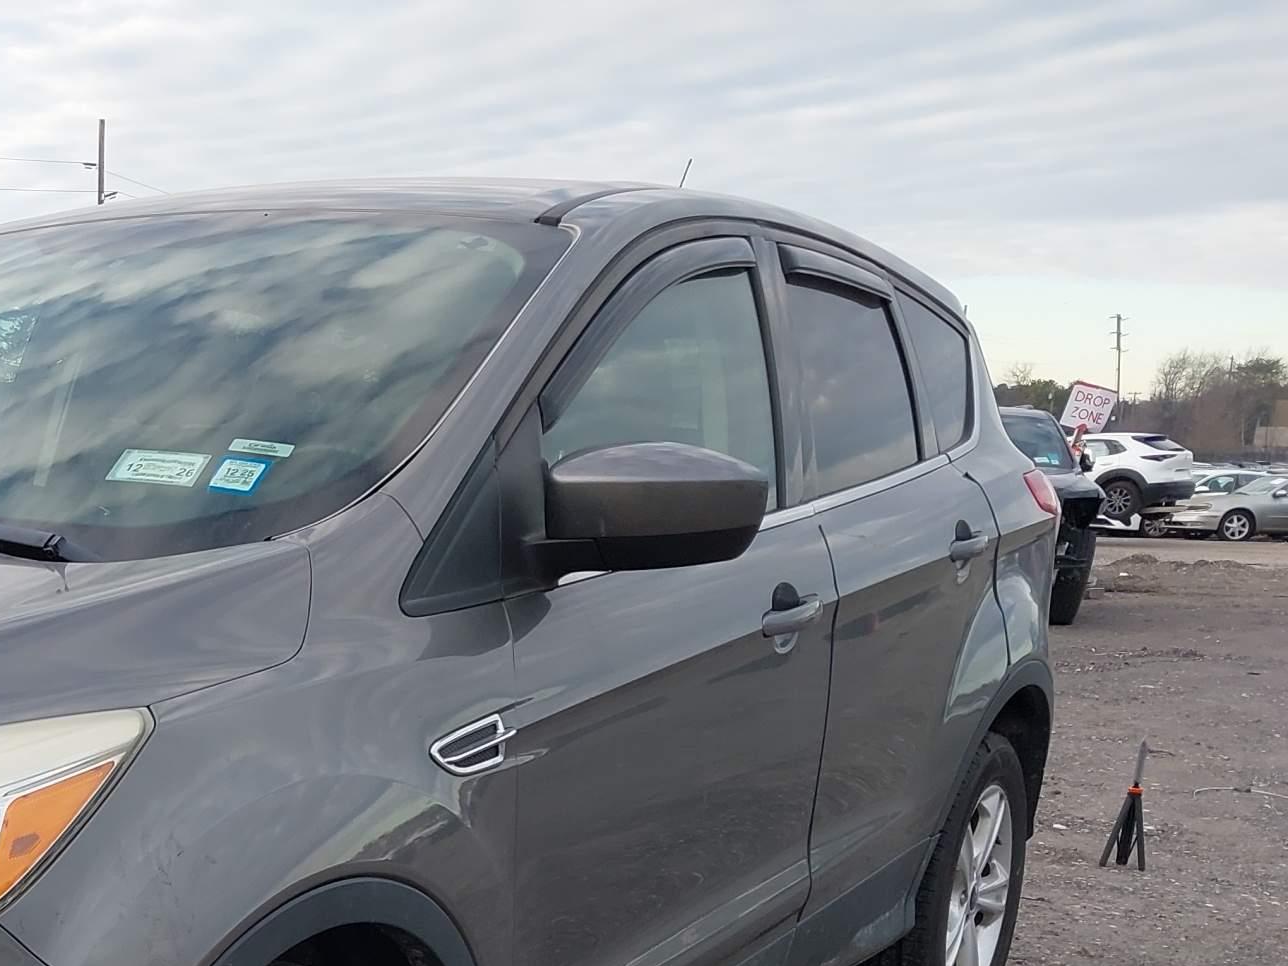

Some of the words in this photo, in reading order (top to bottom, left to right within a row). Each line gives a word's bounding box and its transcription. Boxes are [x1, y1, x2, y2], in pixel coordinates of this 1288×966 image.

[1075, 390, 1111, 408] DROP
[1070, 406, 1105, 425] ZONE
[126, 463, 144, 473] 12
[175, 467, 194, 479] 26
[225, 467, 239, 477] 12
